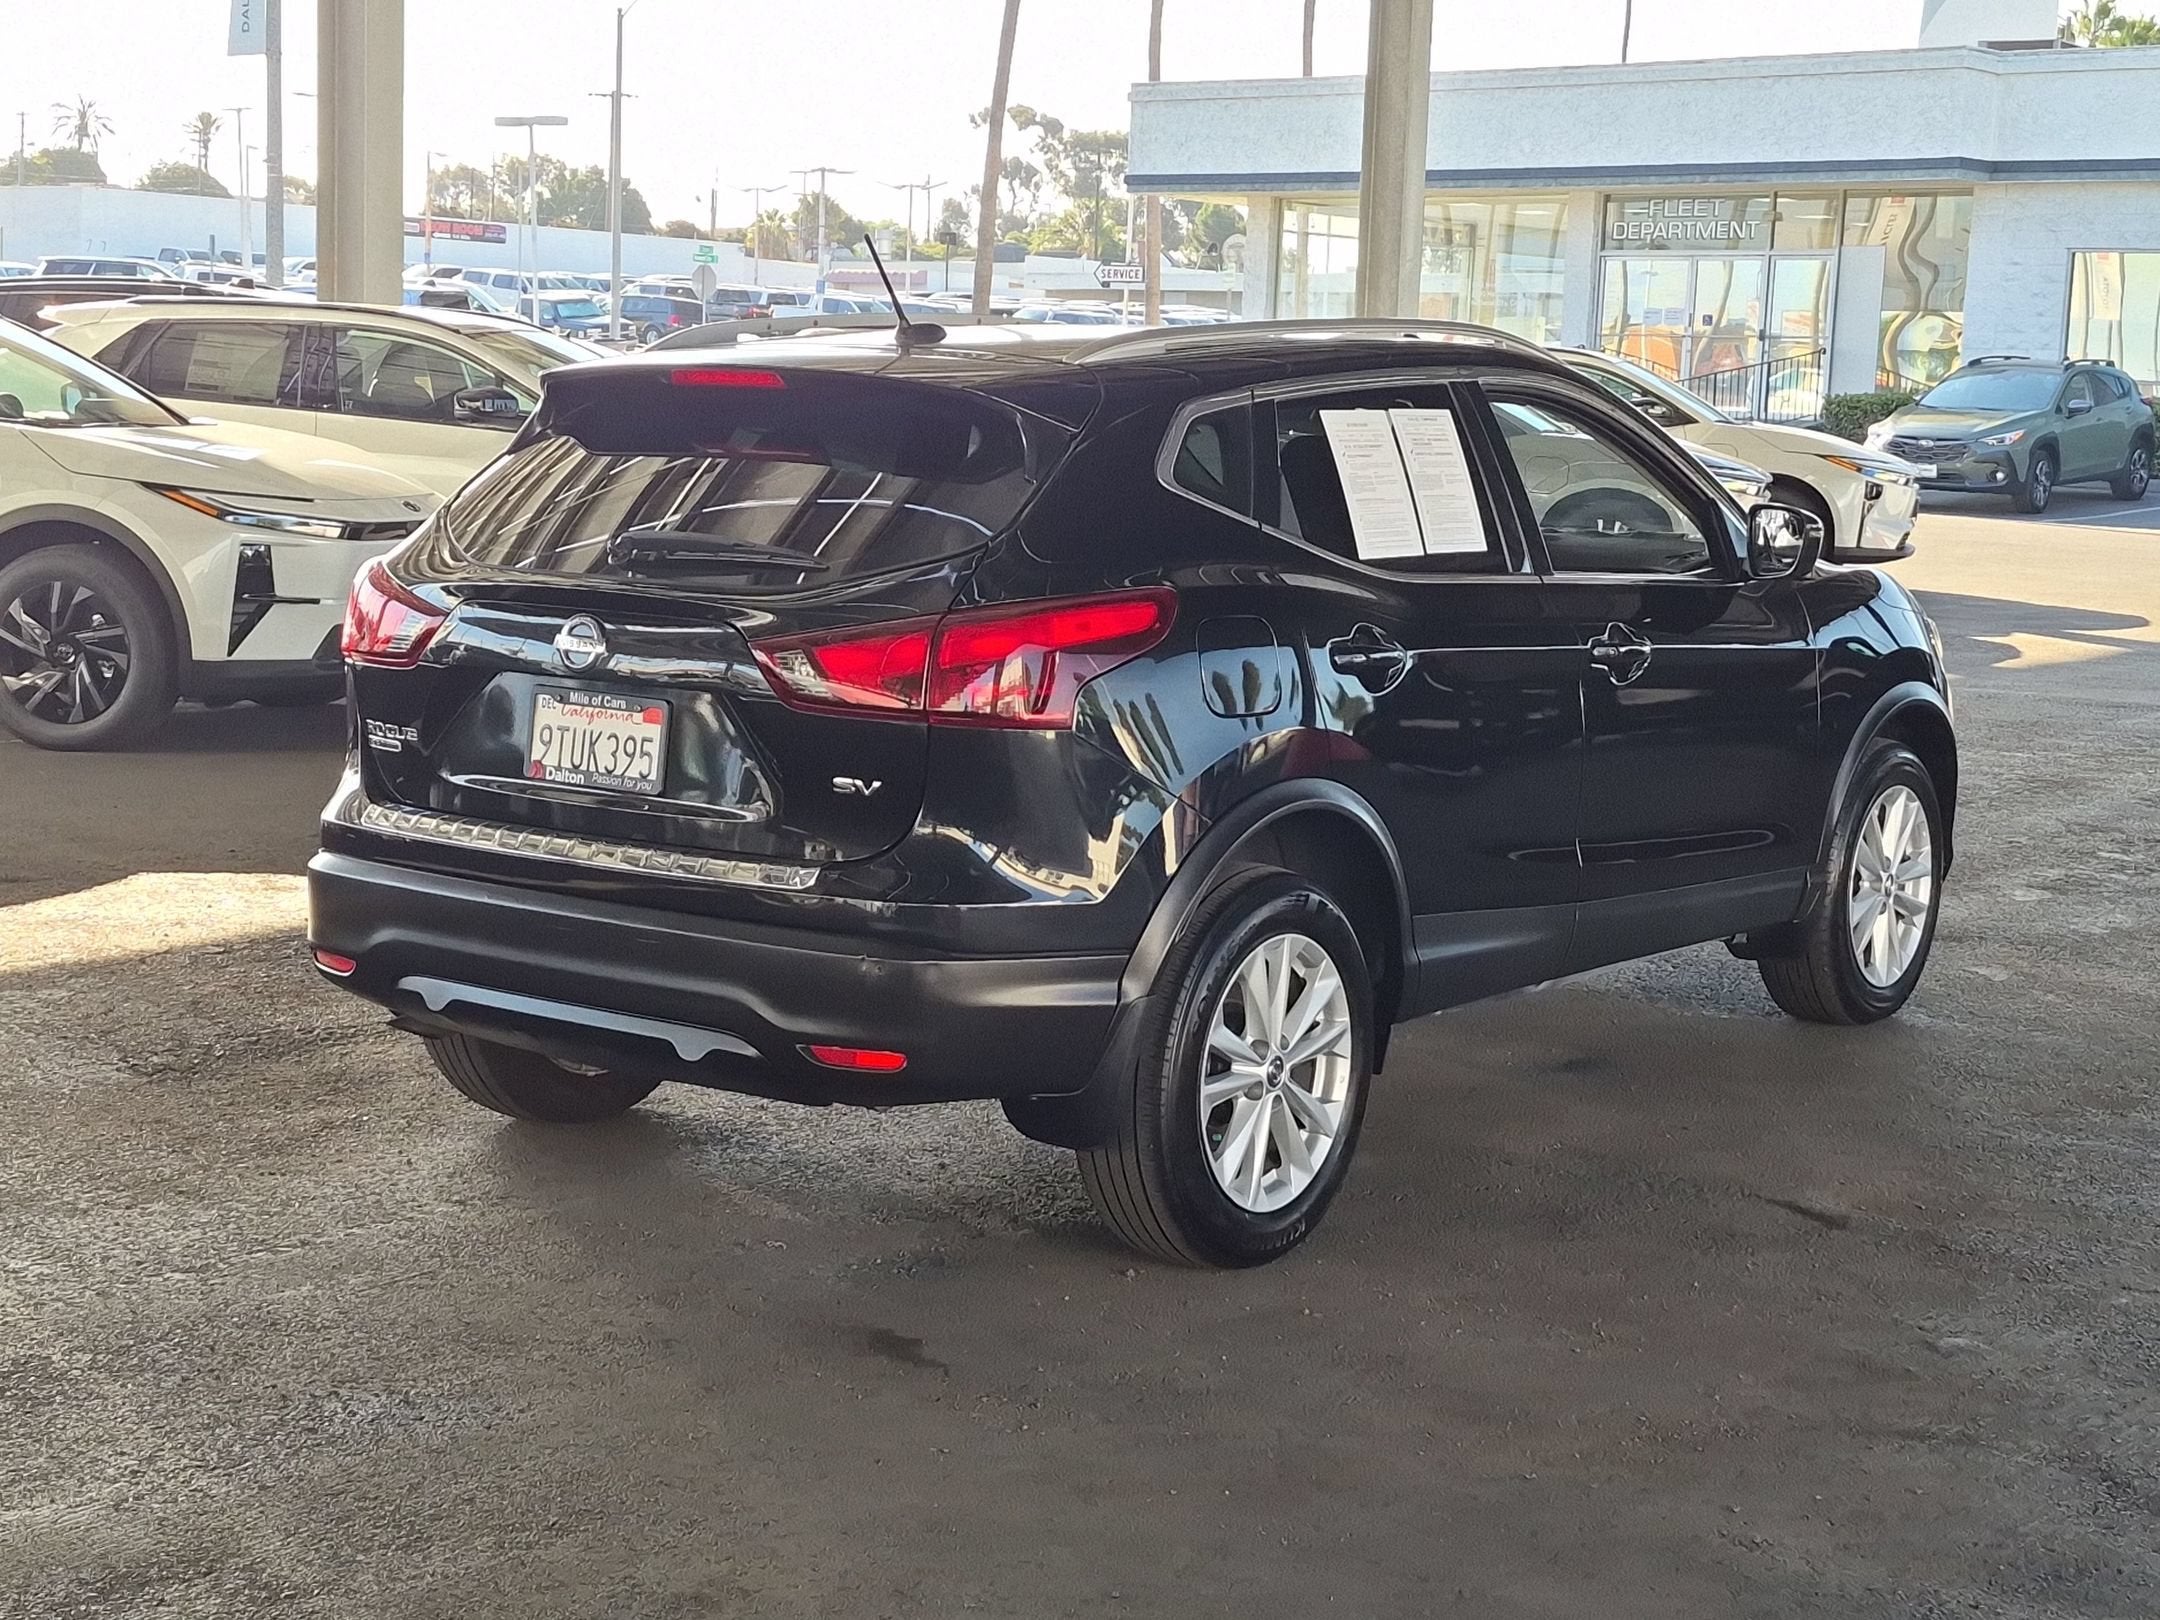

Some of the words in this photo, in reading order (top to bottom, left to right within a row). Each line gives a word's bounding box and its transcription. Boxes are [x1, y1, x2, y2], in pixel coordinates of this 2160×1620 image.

[1648, 198, 1725, 218] FLEET
[1612, 220, 1760, 240] DEPARTMENT
[1101, 269, 1140, 279] SERVICE
[570, 692, 587, 704] Mile
[591, 694, 602, 705] of
[604, 697, 626, 708] Cars
[561, 703, 642, 725] California
[539, 723, 653, 779] 9TUK395
[545, 768, 584, 785] Dalton
[592, 773, 622, 786] Passion
[623, 776, 635, 787] for
[636, 780, 652, 790] you
[833, 777, 882, 796] SV
